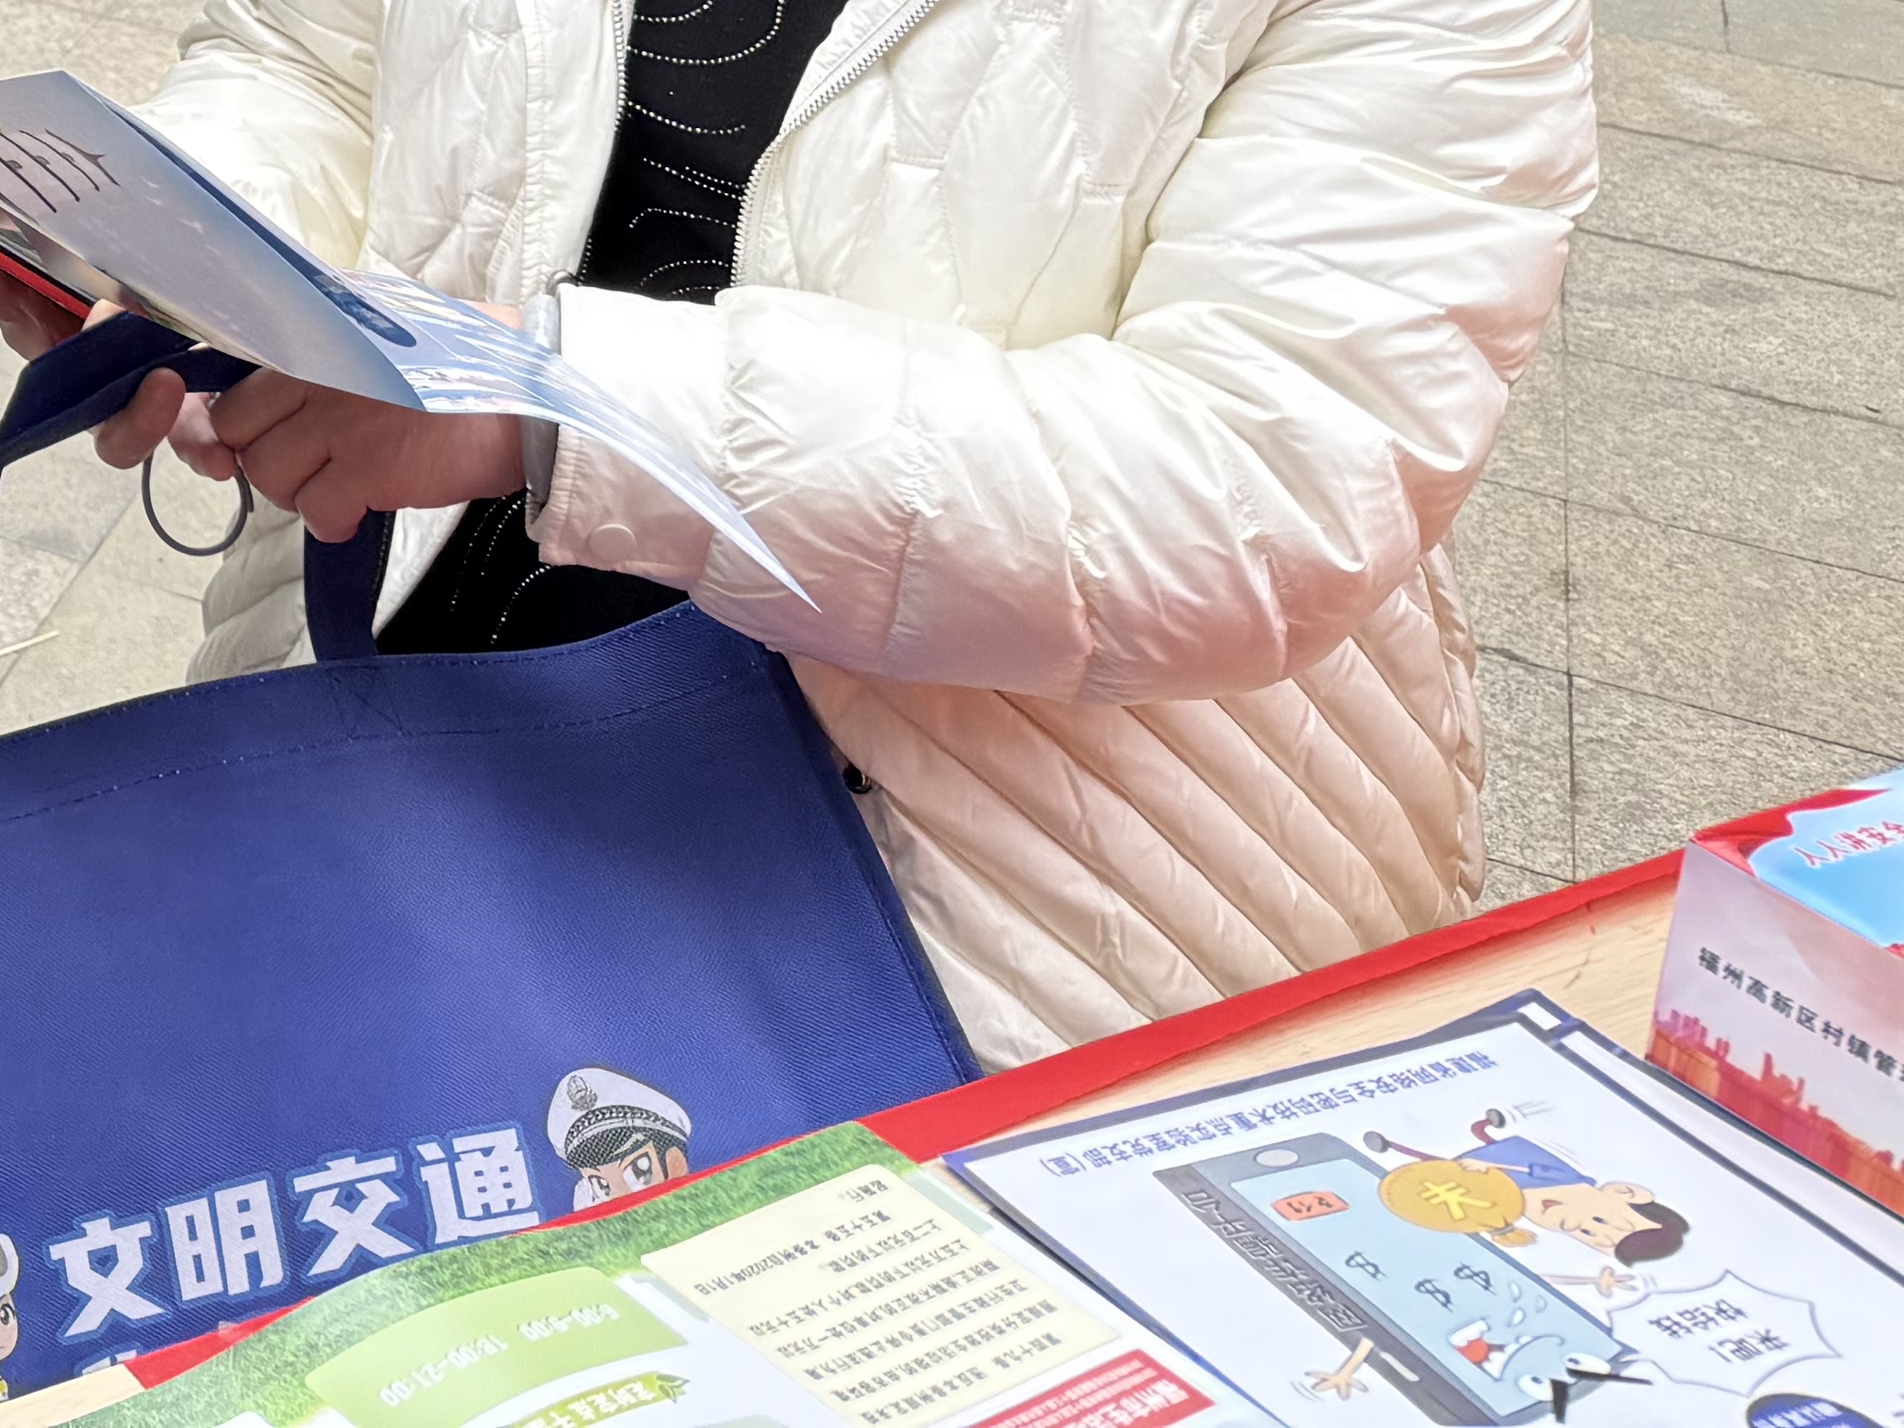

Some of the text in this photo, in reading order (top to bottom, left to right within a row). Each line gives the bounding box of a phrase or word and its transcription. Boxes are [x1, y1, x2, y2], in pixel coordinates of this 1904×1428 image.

[48, 1127, 540, 1338] 文明交通
[1647, 1298, 1750, 1339] 快给钱
[1709, 1329, 1792, 1363] 来吧!
[1059, 1377, 1191, 1427] 福州市生活
